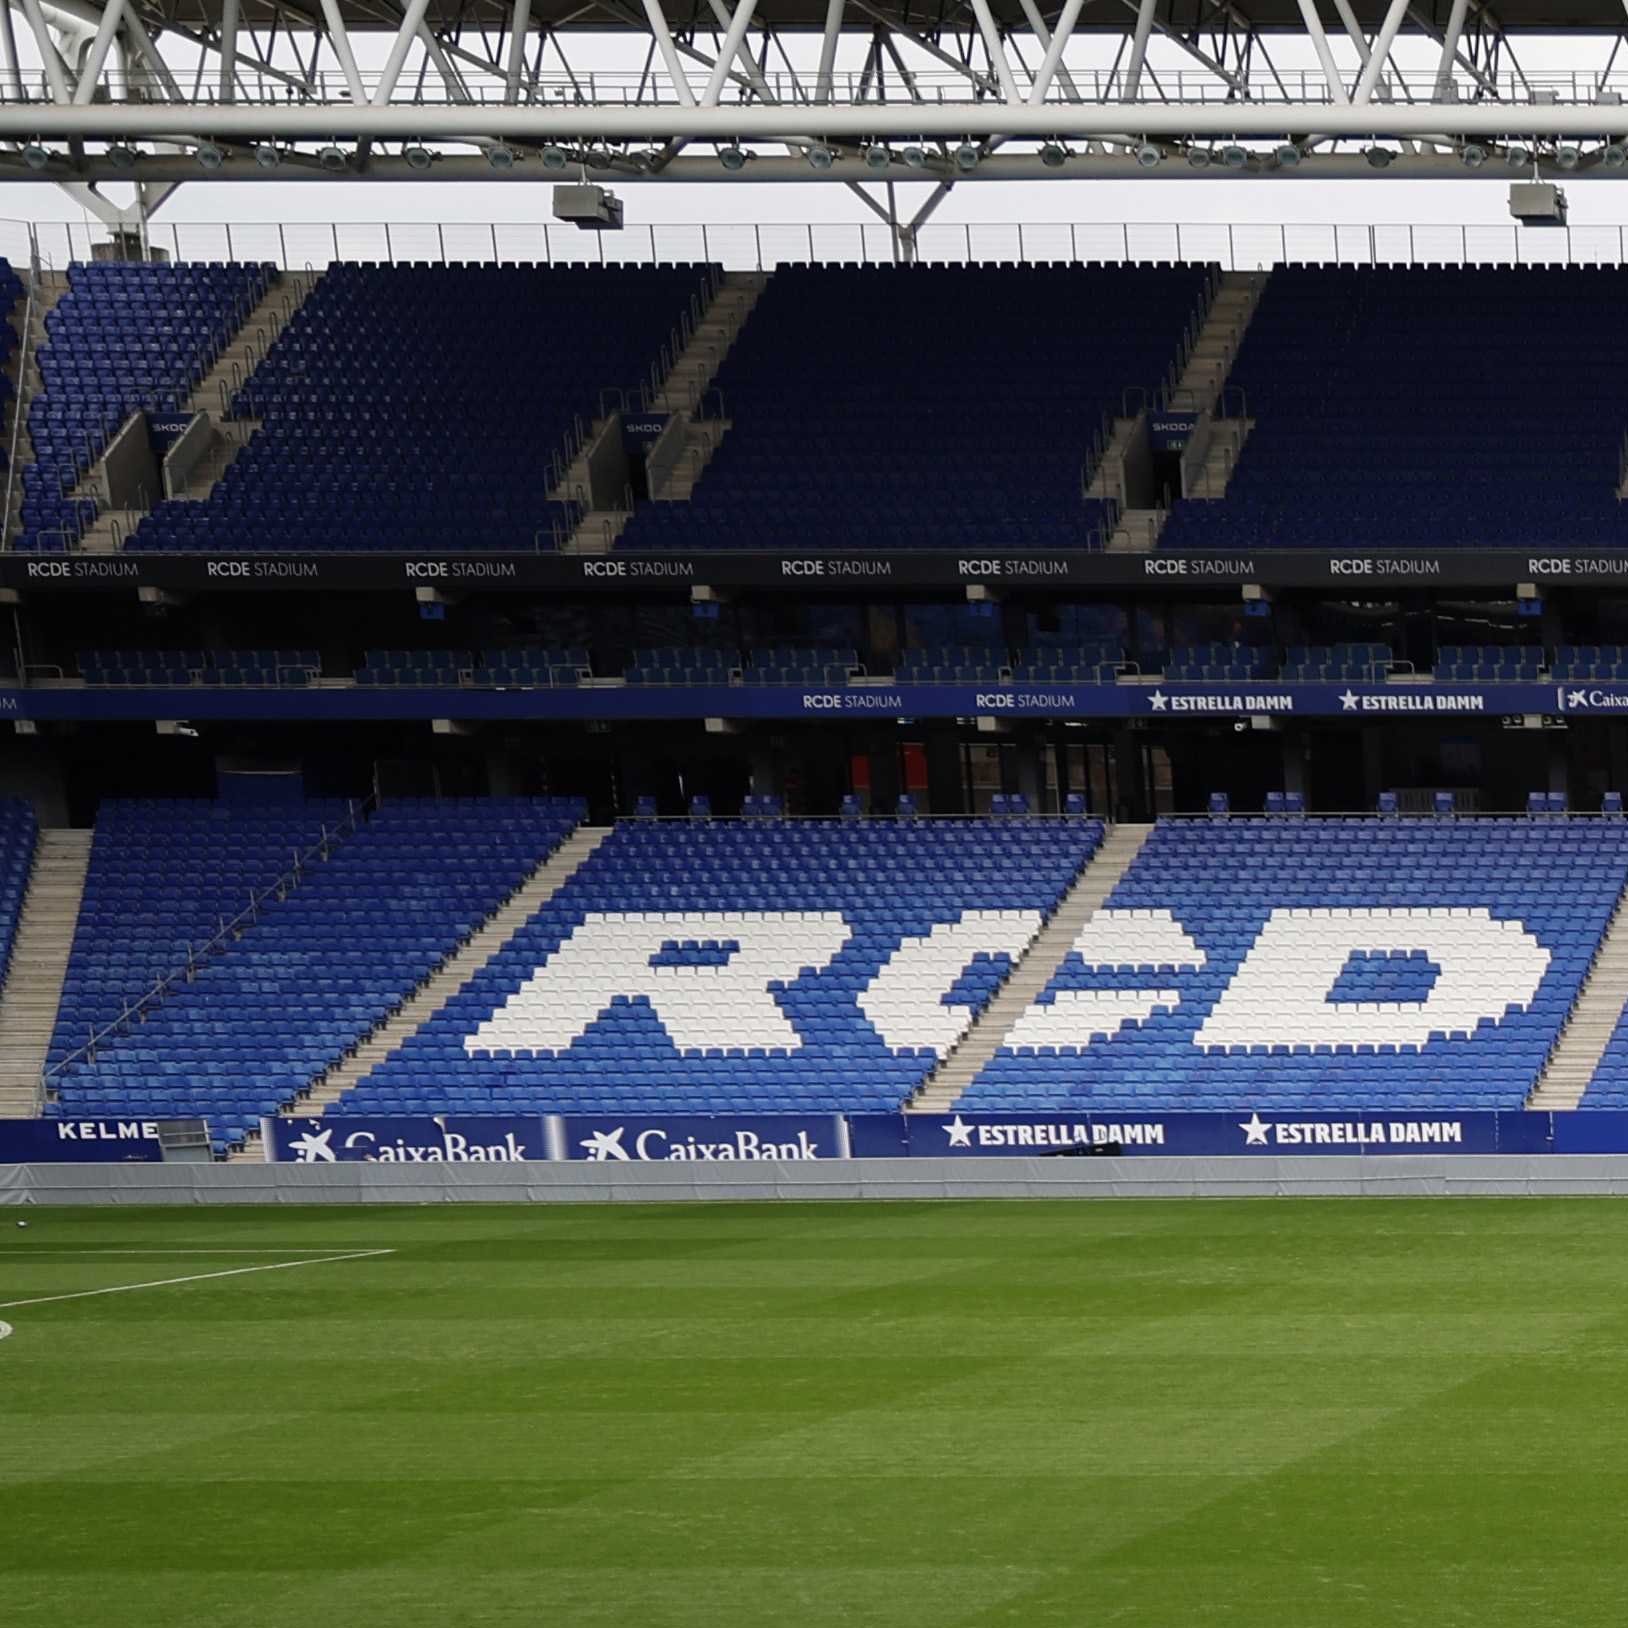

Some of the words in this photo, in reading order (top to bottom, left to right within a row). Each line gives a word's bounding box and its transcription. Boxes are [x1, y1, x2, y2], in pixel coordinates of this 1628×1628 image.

[27, 561, 72, 577] RCDE
[75, 562, 138, 576] STADIUM
[207, 561, 251, 577] RCDE
[254, 562, 317, 576] STADIUM
[405, 561, 449, 577] RCDE
[452, 562, 516, 577] STADIUM
[583, 561, 627, 577] RCDE
[630, 561, 694, 576] STADIUM
[781, 560, 825, 575] RCDE
[828, 560, 891, 575] STADIUM
[958, 559, 1001, 575] RCDE
[1005, 560, 1068, 575] STADIUM
[1144, 559, 1188, 575] RCDE
[1191, 560, 1254, 574] STADIUM
[1330, 559, 1373, 574] RCDE
[1376, 559, 1440, 574] STADIUM
[1528, 558, 1571, 574] RCDE
[803, 694, 842, 709] RCDE
[844, 695, 902, 708] STADIUM
[976, 693, 1015, 708] RCDE
[1018, 694, 1075, 708] STADIUM
[1171, 696, 1243, 710] ESTRELLA
[1245, 696, 1292, 710] DAMM
[1362, 695, 1434, 710] ESTRELLA
[1436, 695, 1484, 710] DAMM
[462, 906, 1552, 1058] RCD
[55, 1122, 160, 1140] KELME
[978, 1125, 1089, 1145] ESTRELLA
[1092, 1124, 1164, 1144] DAMM
[1276, 1123, 1386, 1143] ESTRELLA
[1389, 1122, 1462, 1143] DAMM
